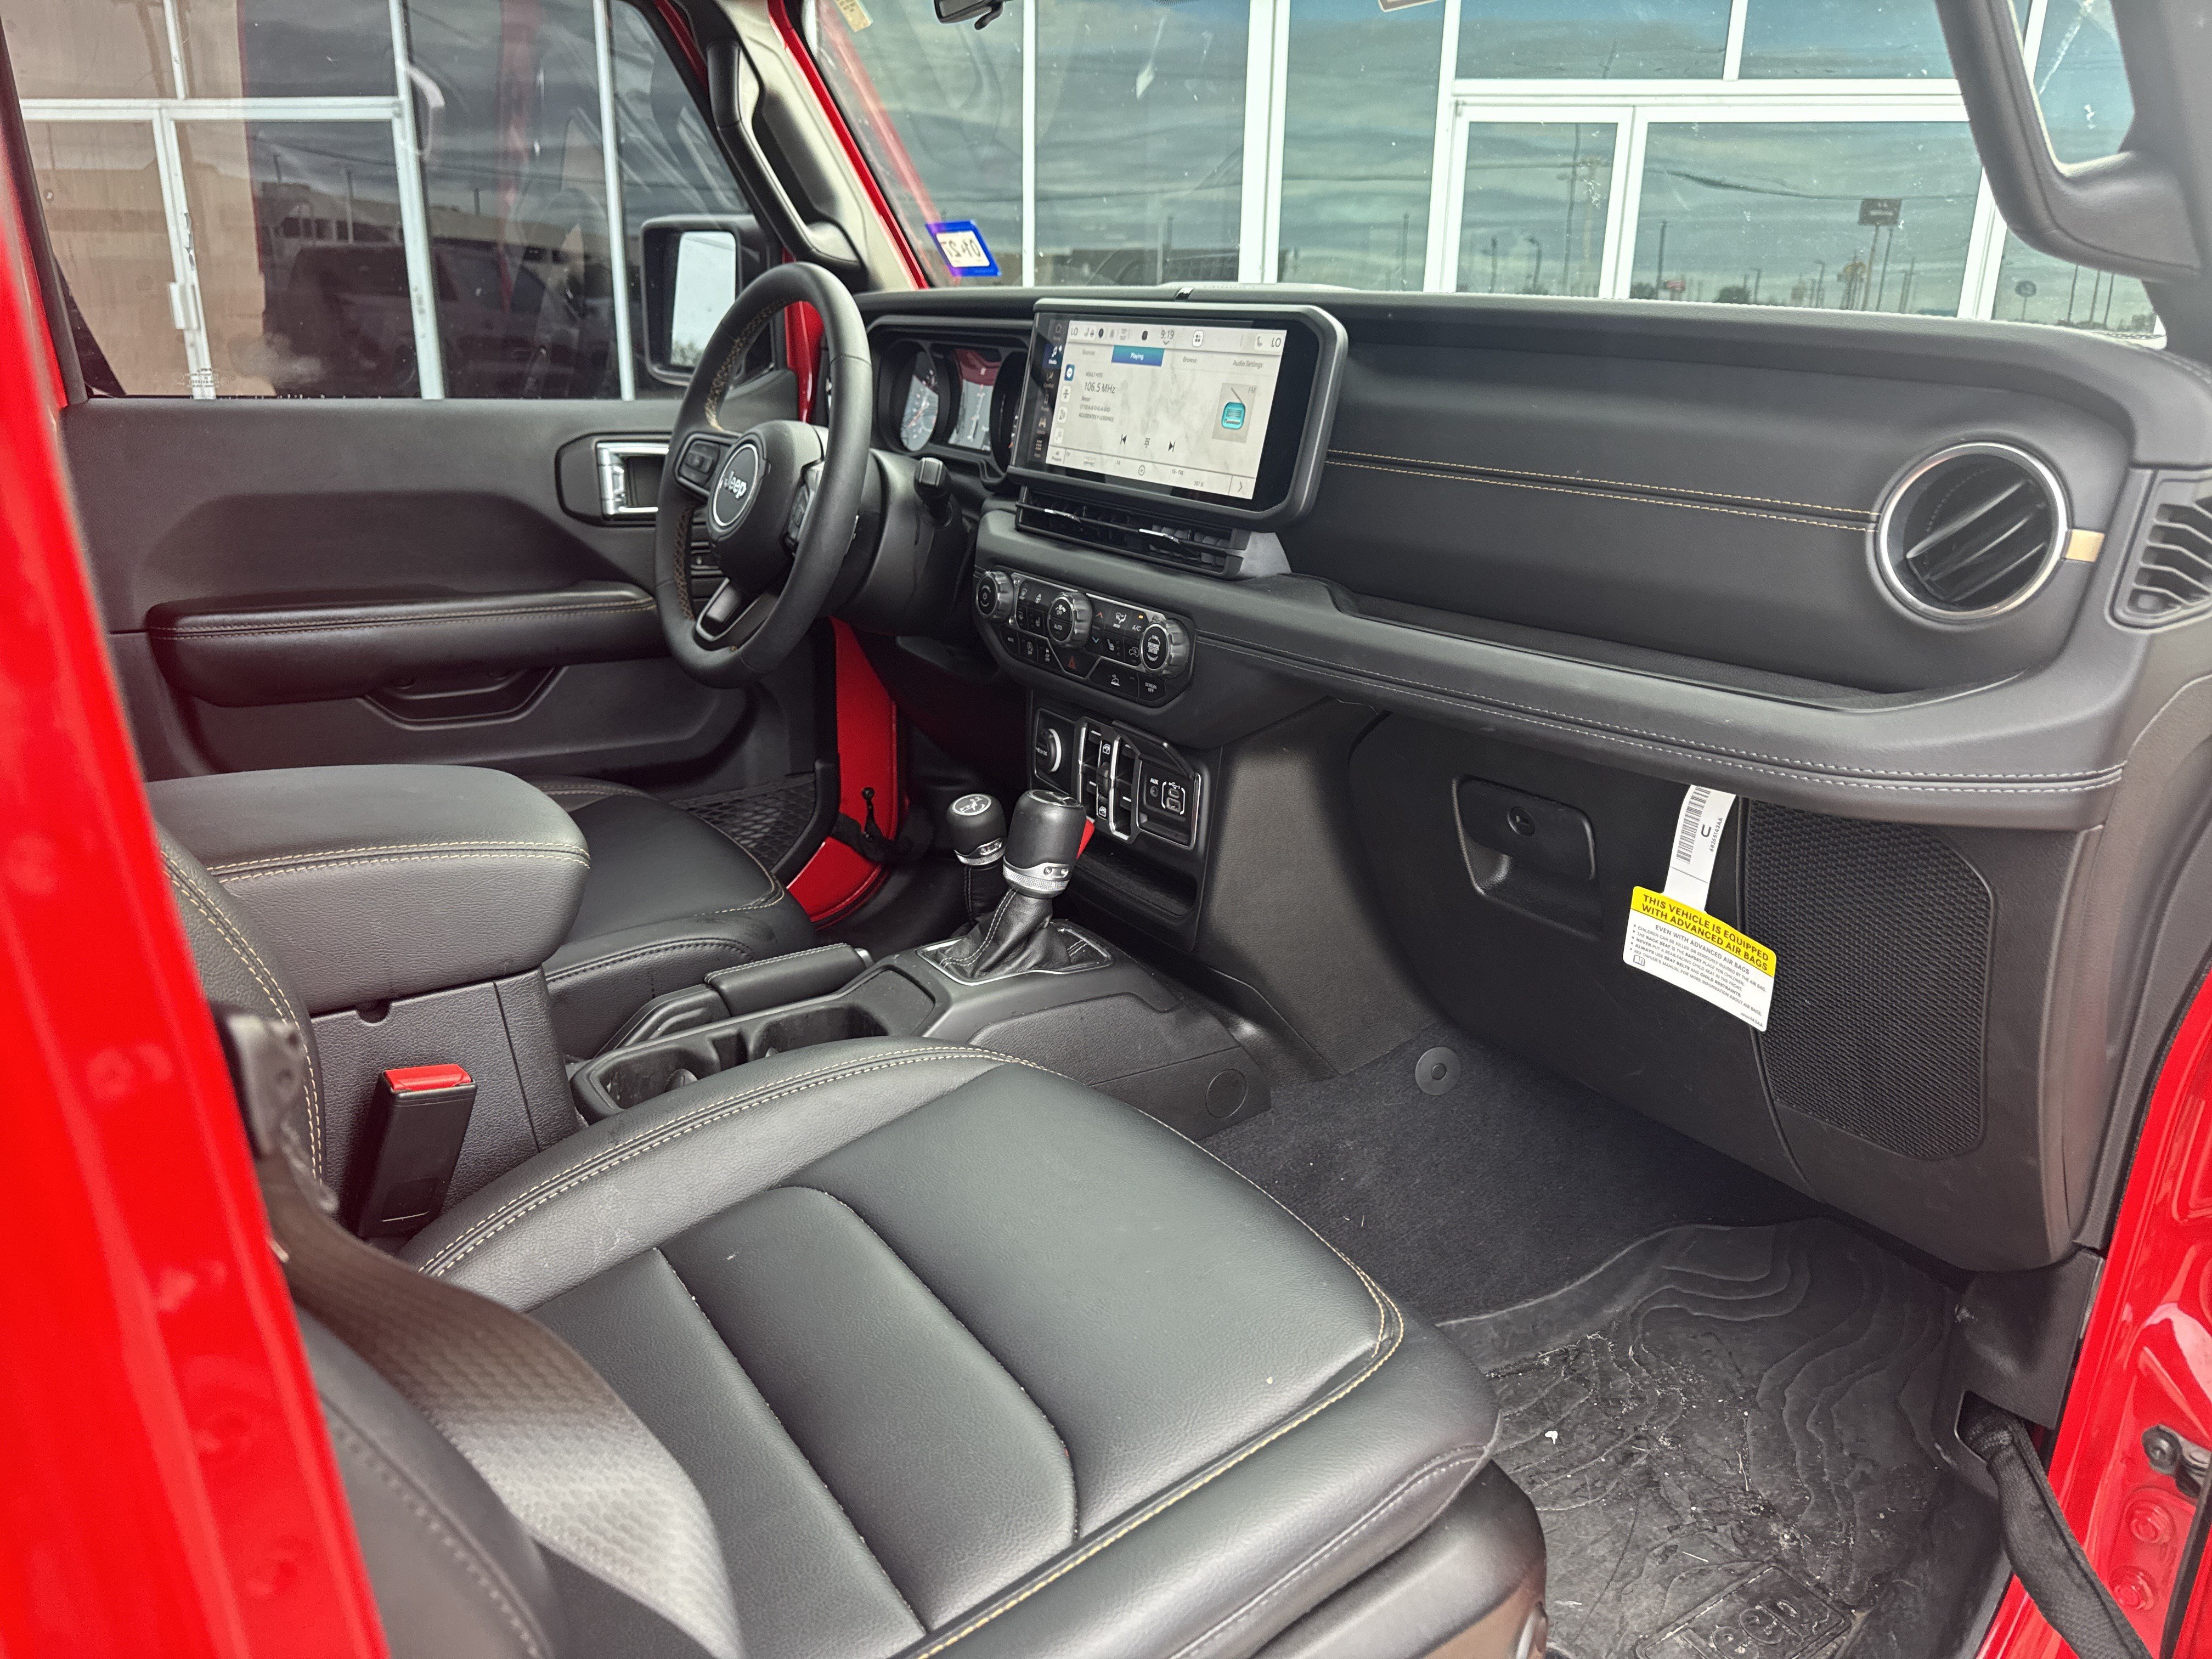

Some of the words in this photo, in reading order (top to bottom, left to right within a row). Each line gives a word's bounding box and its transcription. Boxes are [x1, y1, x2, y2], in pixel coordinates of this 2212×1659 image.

[1161, 330, 1174, 340] 9:19
[1271, 337, 1282, 347] LO
[1130, 352, 1144, 361] Playing
[1245, 360, 1263, 369] Settings
[1084, 381, 1101, 392] 106.5
[1101, 383, 1116, 394] MHz
[723, 470, 747, 499] Jeep
[1701, 824, 1712, 837] U
[1642, 903, 1668, 919] WITH
[1670, 916, 1723, 945] ADVANCED
[1725, 942, 1741, 956] AIR
[1743, 951, 1768, 970] BAGS
[1644, 894, 1667, 909] THIS
[1669, 904, 1710, 929] VEHICLE
[1712, 924, 1722, 934] IS
[1724, 930, 1769, 961] EQUIPPED
[1635, 944, 1654, 954] ALWAYS
[1677, 961, 1690, 970] BELTS
[1700, 973, 1714, 982] CHILD
[1636, 938, 1651, 947] NEVER
[1665, 950, 1691, 964] REAR-FACING
[1692, 962, 1705, 970] CHILD
[1638, 926, 1658, 937] CHILDREN
[1675, 941, 1690, 950] KILLED
[1697, 951, 1719, 964] SERIOUSLY
[1719, 963, 1735, 974] INJURED
[1646, 935, 1658, 944] BACK
[1685, 952, 1702, 963] SAFEST
[1702, 960, 1715, 969] PLACE
[1655, 924, 1672, 935] EVEN
[1673, 932, 1689, 943] WITH
[1690, 940, 1722, 959] ADVANCED
[1723, 956, 1733, 965] AIR
[1734, 962, 1750, 974] BAGS
[1643, 953, 1662, 964] OWNER'S
[1662, 961, 1679, 972] MANUAL
[1690, 974, 1701, 983] MORE
[1702, 980, 1729, 997] INFORMATION
[1729, 995, 1743, 1005] ABOUT
